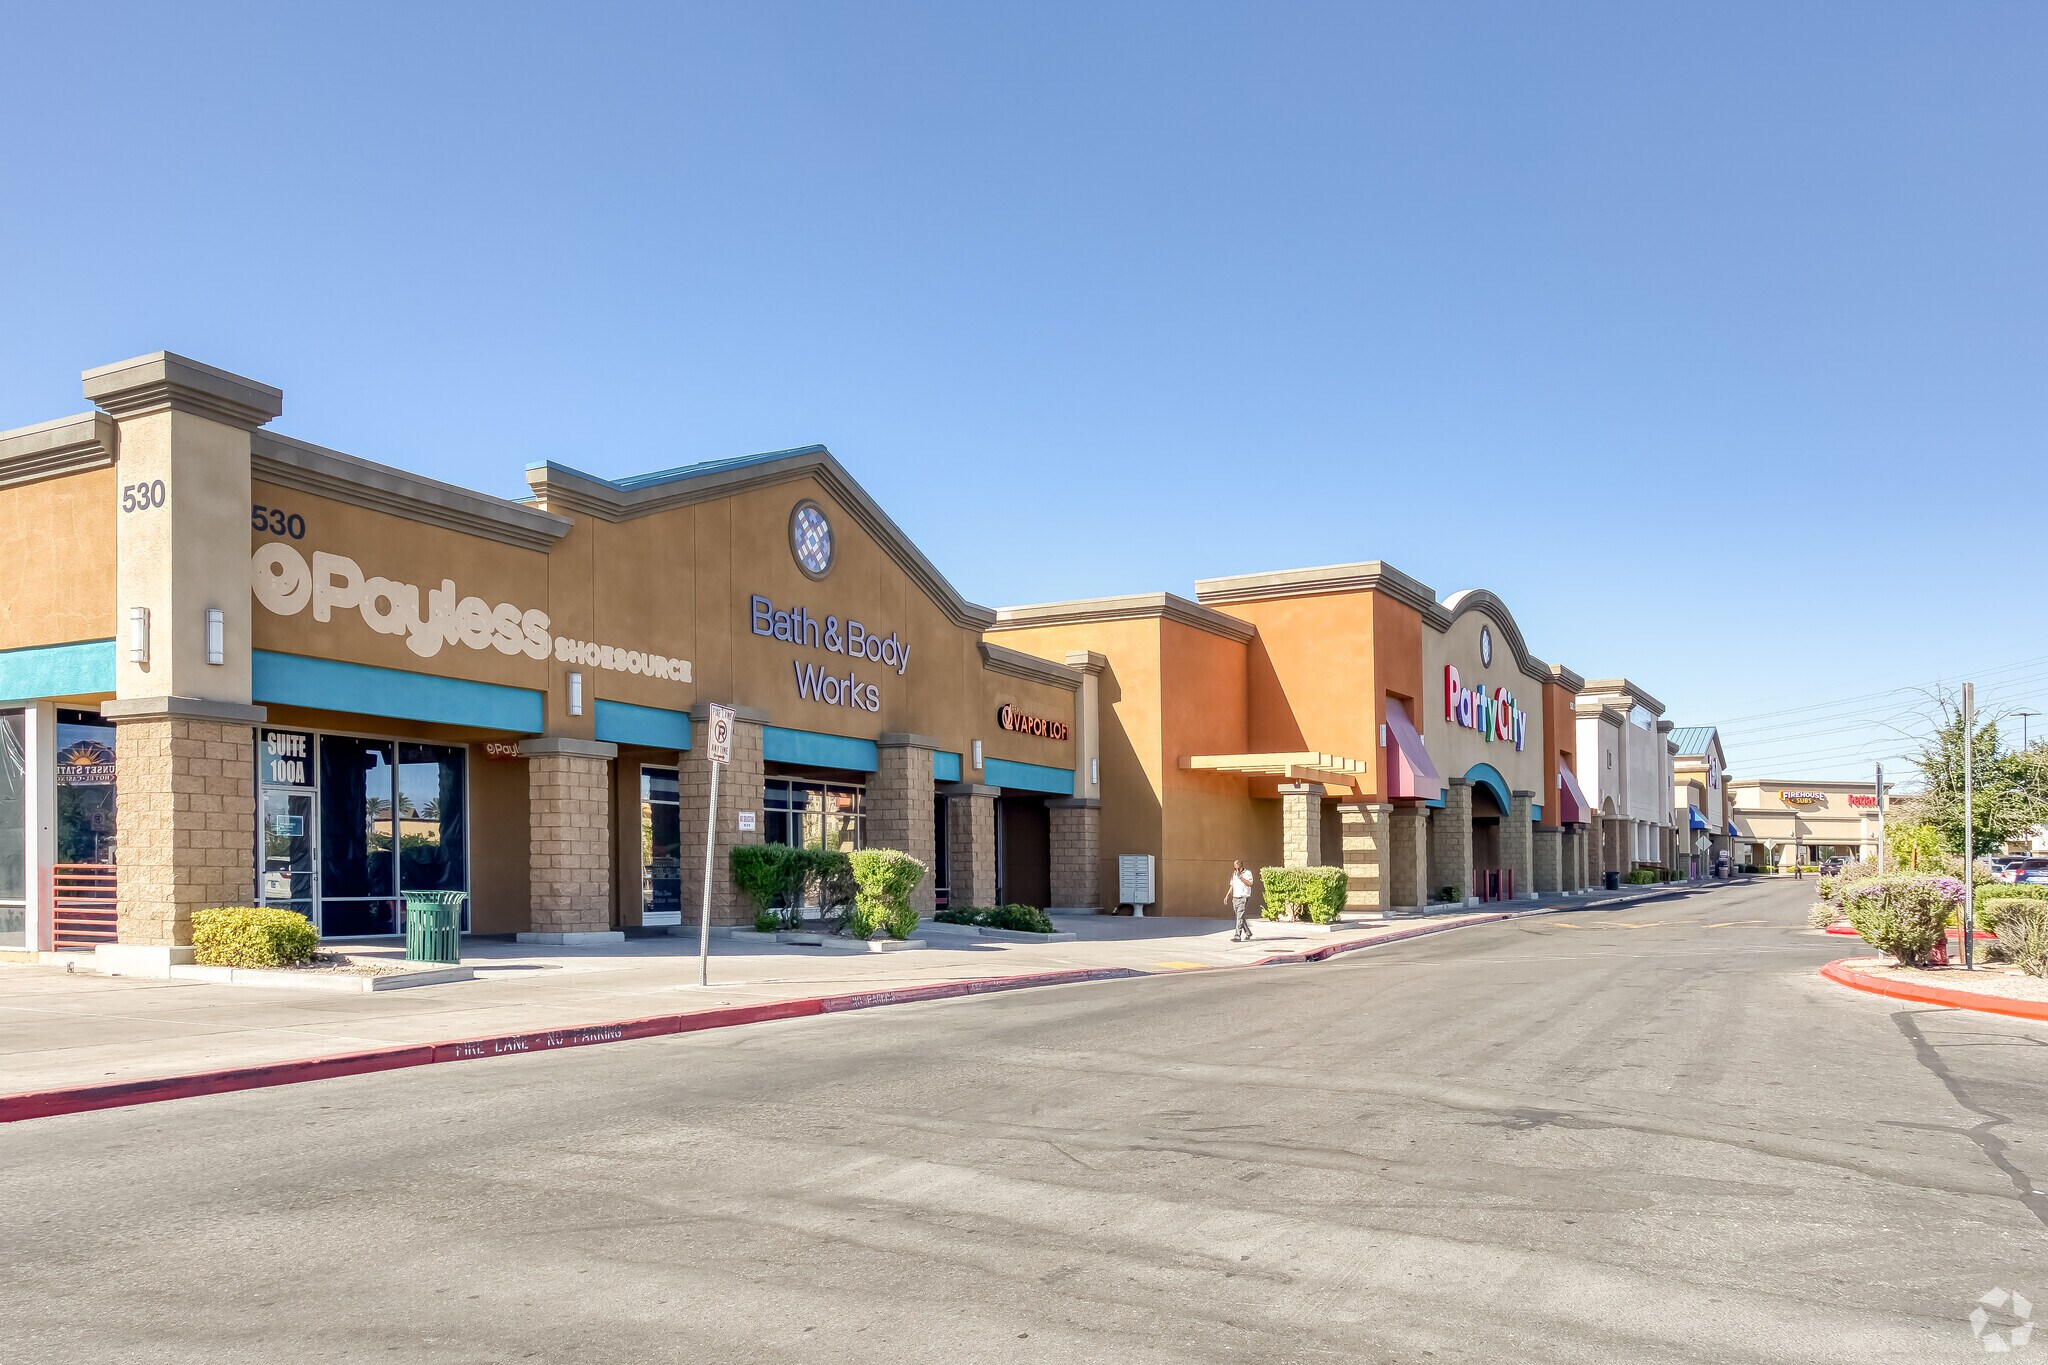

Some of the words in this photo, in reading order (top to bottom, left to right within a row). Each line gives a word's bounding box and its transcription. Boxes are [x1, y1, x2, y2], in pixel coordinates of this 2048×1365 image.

[122, 479, 166, 513] 530
[251, 504, 305, 540] 530
[312, 550, 552, 660] Payless
[751, 595, 819, 648] Bath
[823, 615, 845, 654] &
[847, 620, 911, 675] Body
[794, 660, 880, 712] Works
[1013, 713, 1048, 736] VAPOR
[1049, 721, 1070, 740] LOFT
[267, 732, 306, 758] SUITE
[495, 742, 521, 757] Payl
[270, 759, 305, 783] 100A
[1782, 791, 1825, 801] FIREHOUSE
